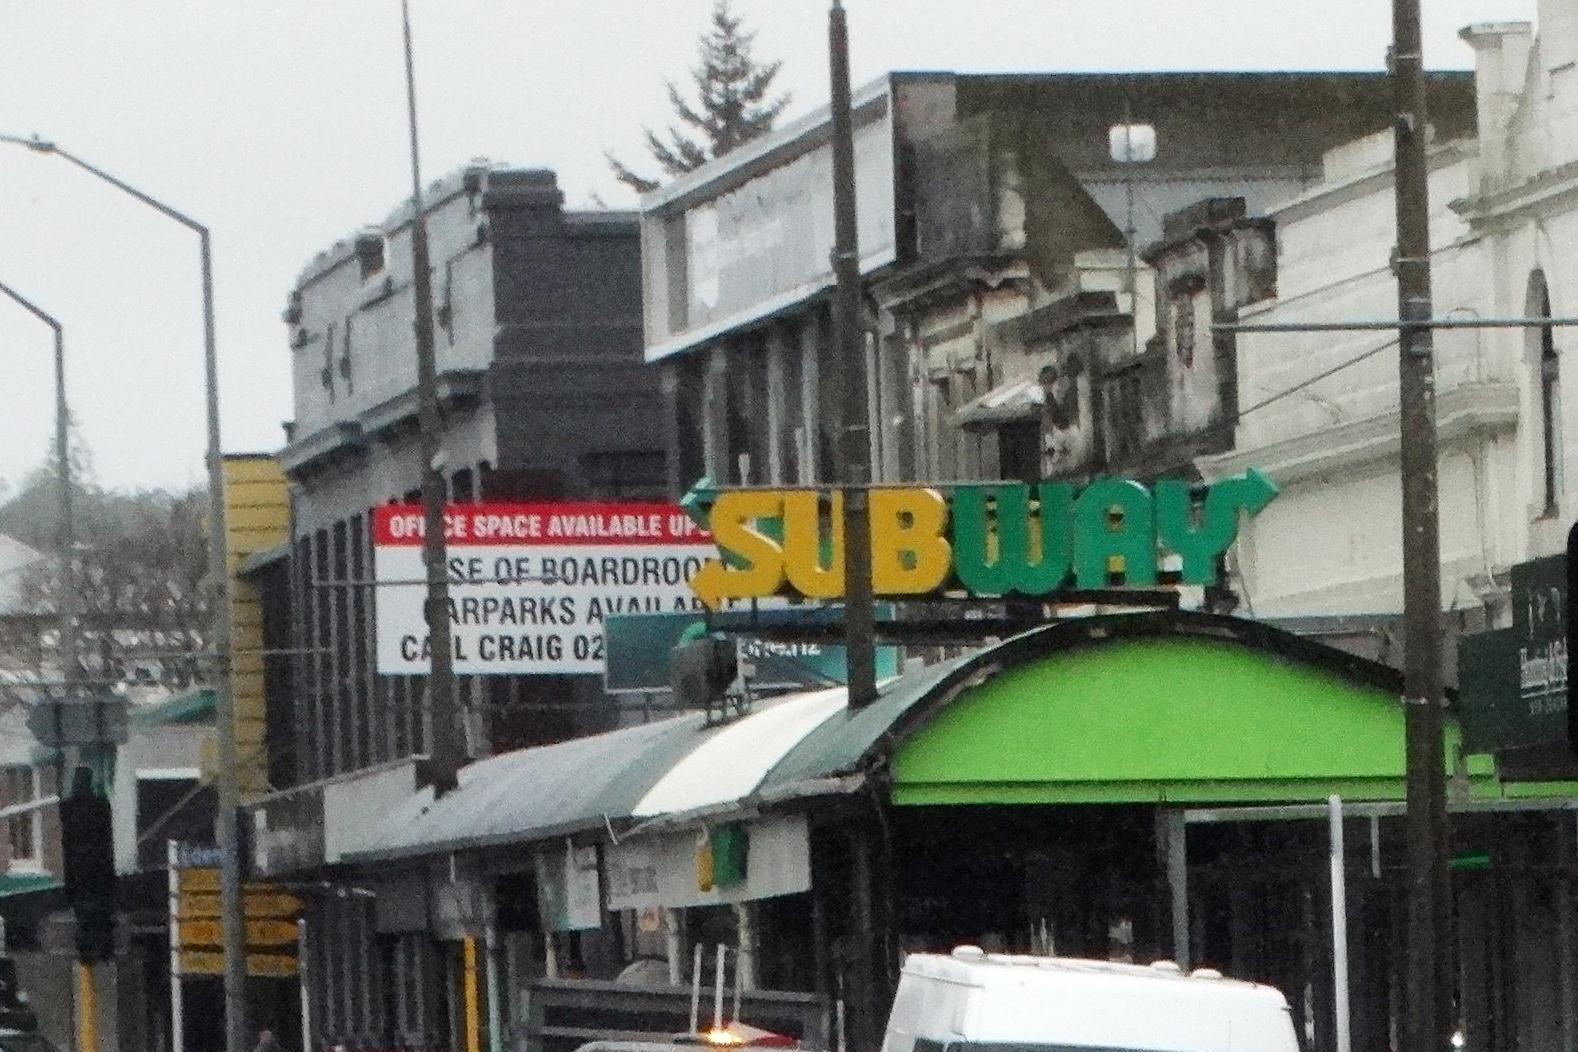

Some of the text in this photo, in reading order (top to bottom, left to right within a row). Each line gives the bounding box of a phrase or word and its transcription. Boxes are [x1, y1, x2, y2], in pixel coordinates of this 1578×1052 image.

[473, 514, 541, 538] SPACE
[548, 514, 661, 537] AVAILABLE
[690, 467, 1280, 612] SUBWAY
[494, 557, 532, 584] OF
[541, 556, 727, 586] BOARDROO
[424, 597, 576, 626] ARPARKS
[478, 634, 563, 661] CRAIG
